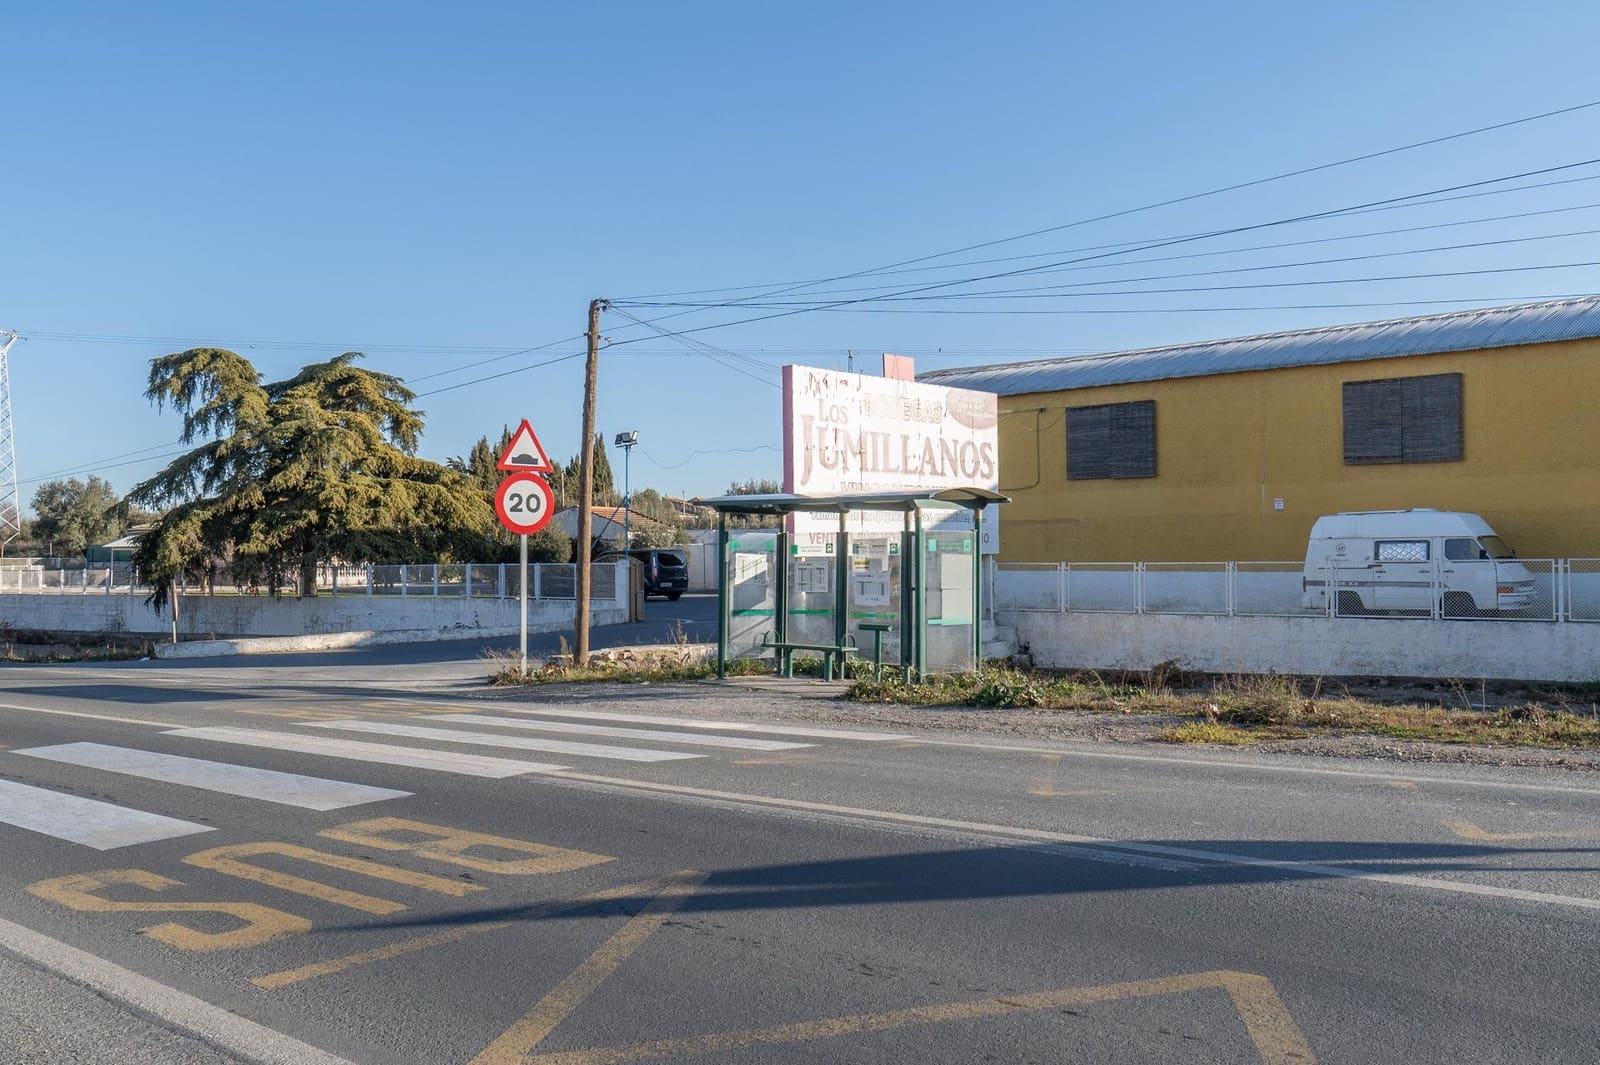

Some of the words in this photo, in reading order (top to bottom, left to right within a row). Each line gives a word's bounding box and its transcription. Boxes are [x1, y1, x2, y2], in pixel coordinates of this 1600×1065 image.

[800, 414, 994, 486] JUMILLANOS
[509, 493, 541, 513] 20
[25, 816, 619, 951] BUS
